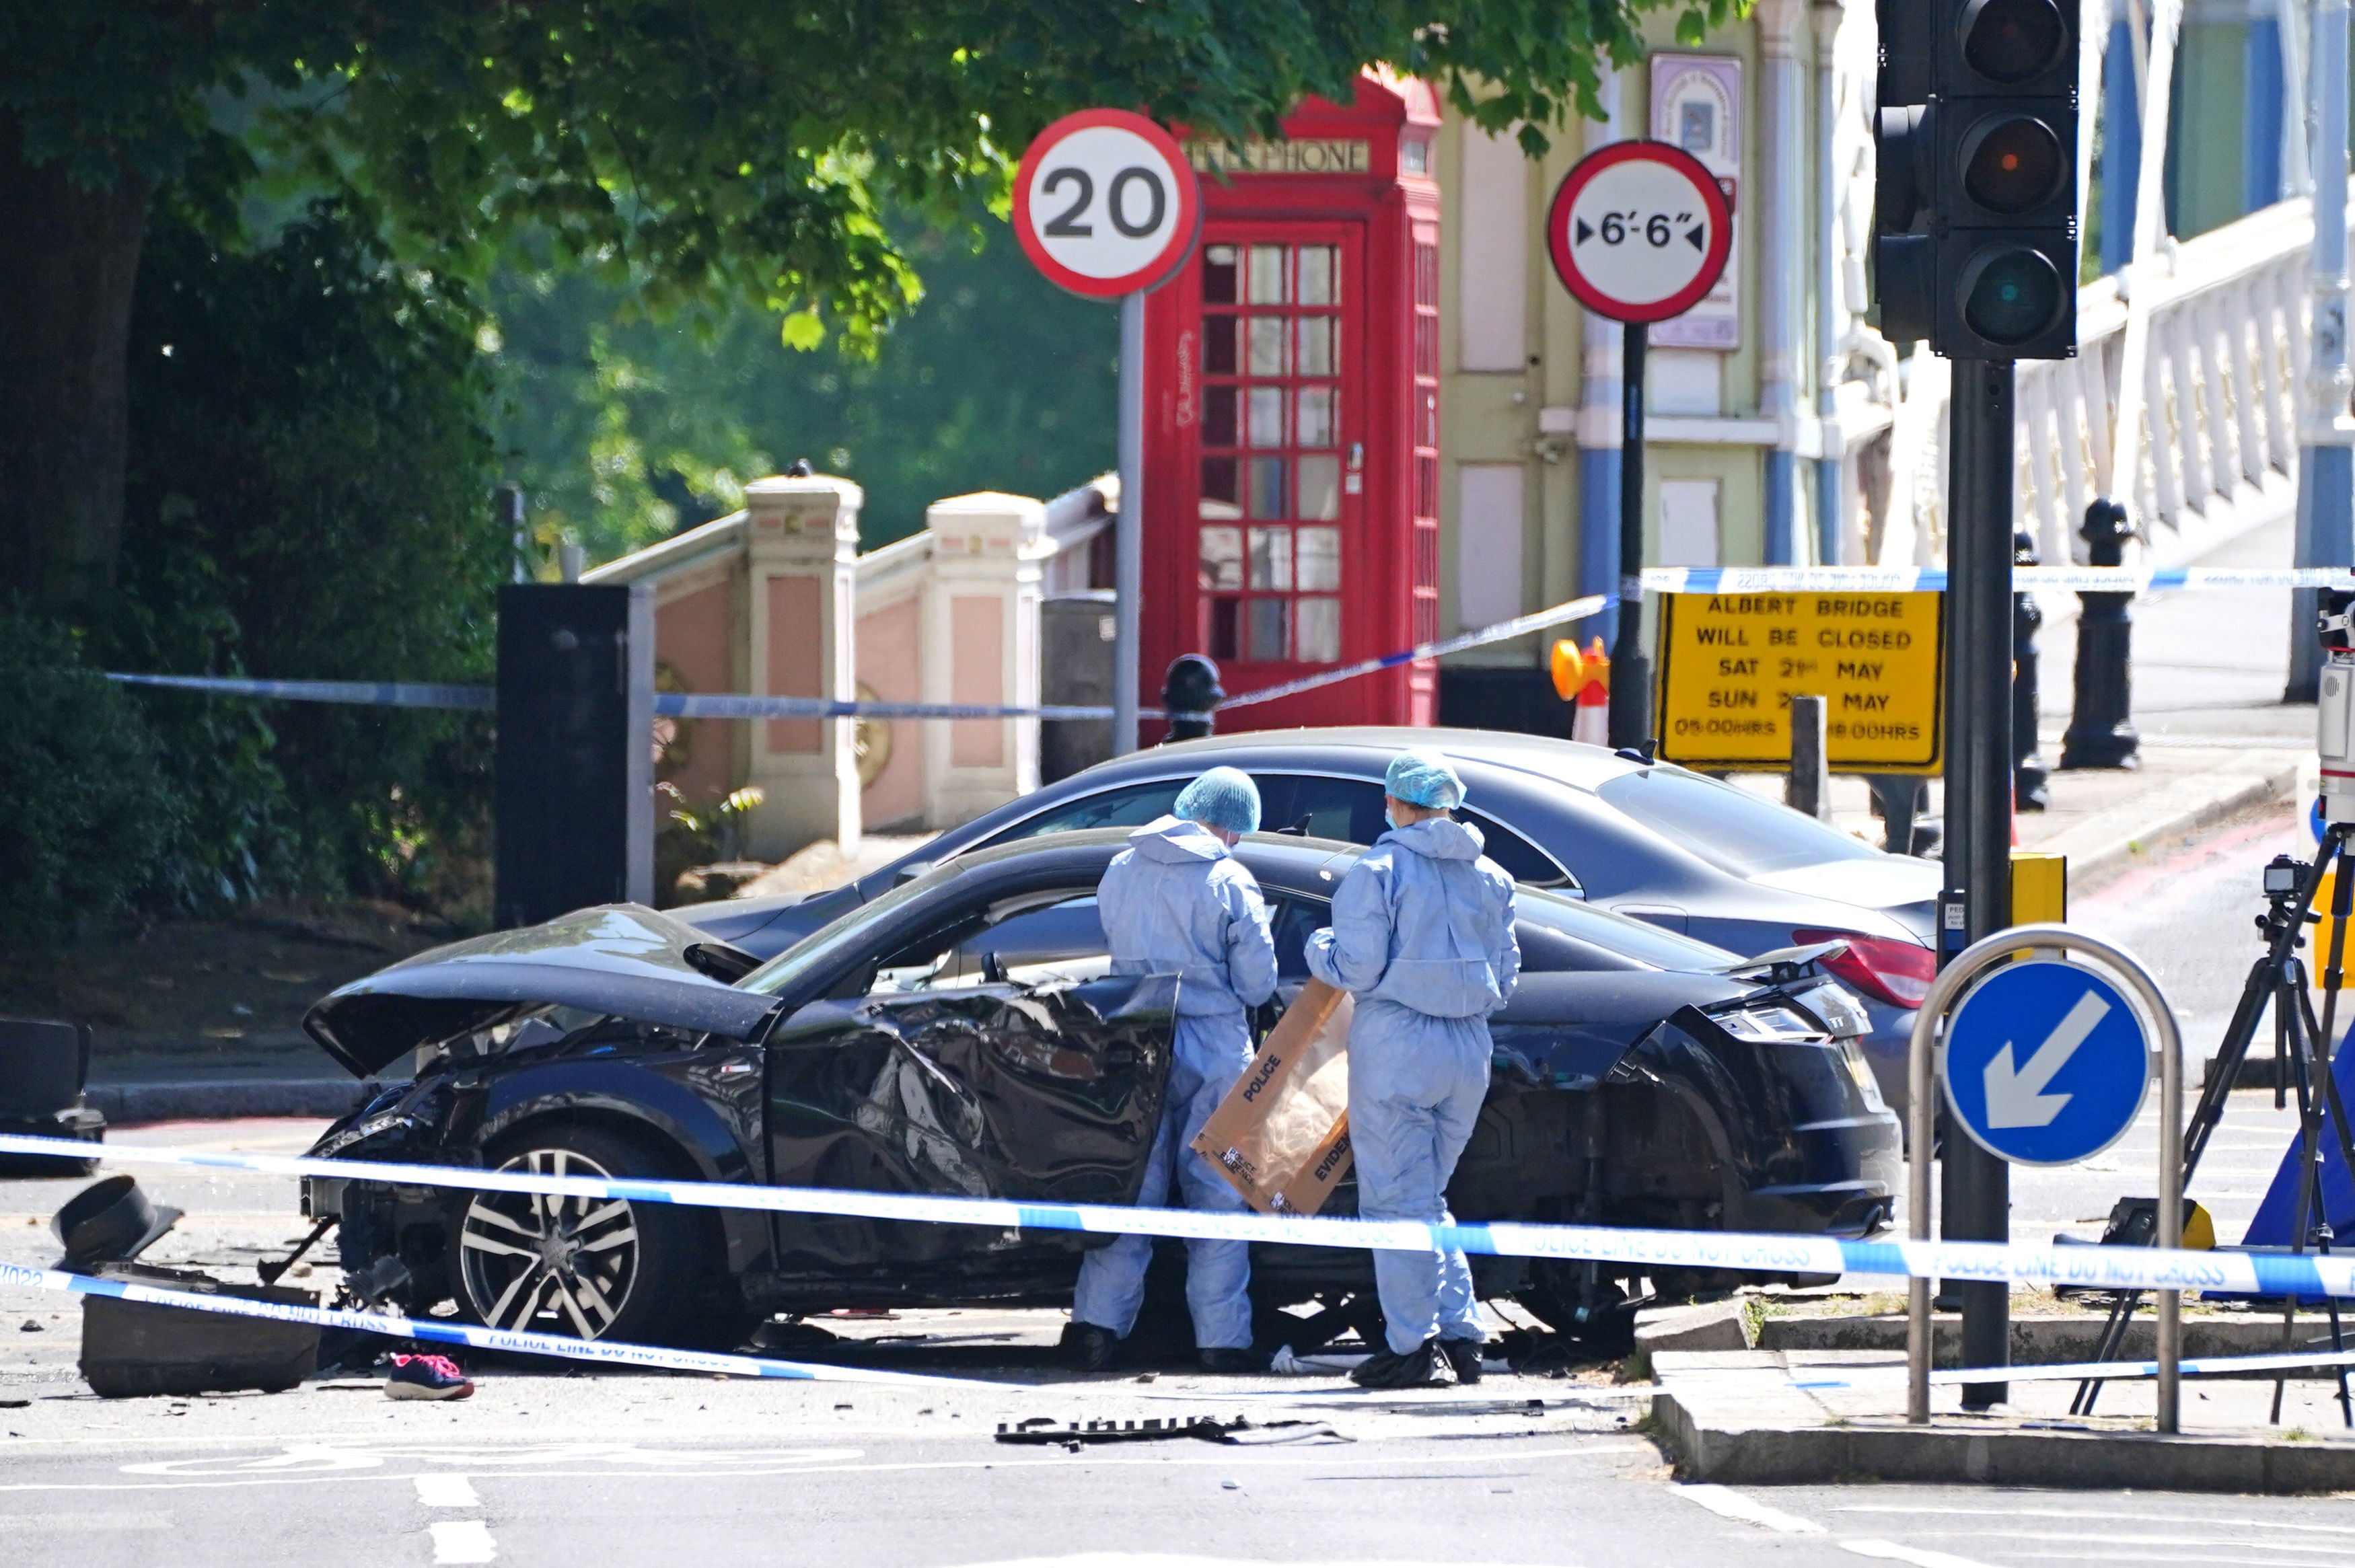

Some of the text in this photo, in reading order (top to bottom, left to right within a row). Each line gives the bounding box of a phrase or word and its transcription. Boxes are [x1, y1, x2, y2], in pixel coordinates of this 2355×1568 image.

[1042, 166, 1166, 238] 20
[1708, 597, 1904, 618] ALBERT BRIDGE
[1696, 626, 1912, 649] WILL BE CLOSED
[1718, 657, 1760, 677] SAT
[1836, 661, 1884, 681] MAY
[1707, 689, 1758, 709] SUN
[1841, 692, 1890, 712] MAY
[1243, 1053, 1281, 1103] POLICE
[1220, 1151, 1256, 1185] EVIDENCE
[1229, 1146, 1257, 1174] POLICE
[1601, 1235, 1646, 1259] LINE
[1931, 1253, 2225, 1286] POLICE LINE DO NOT CROSS
